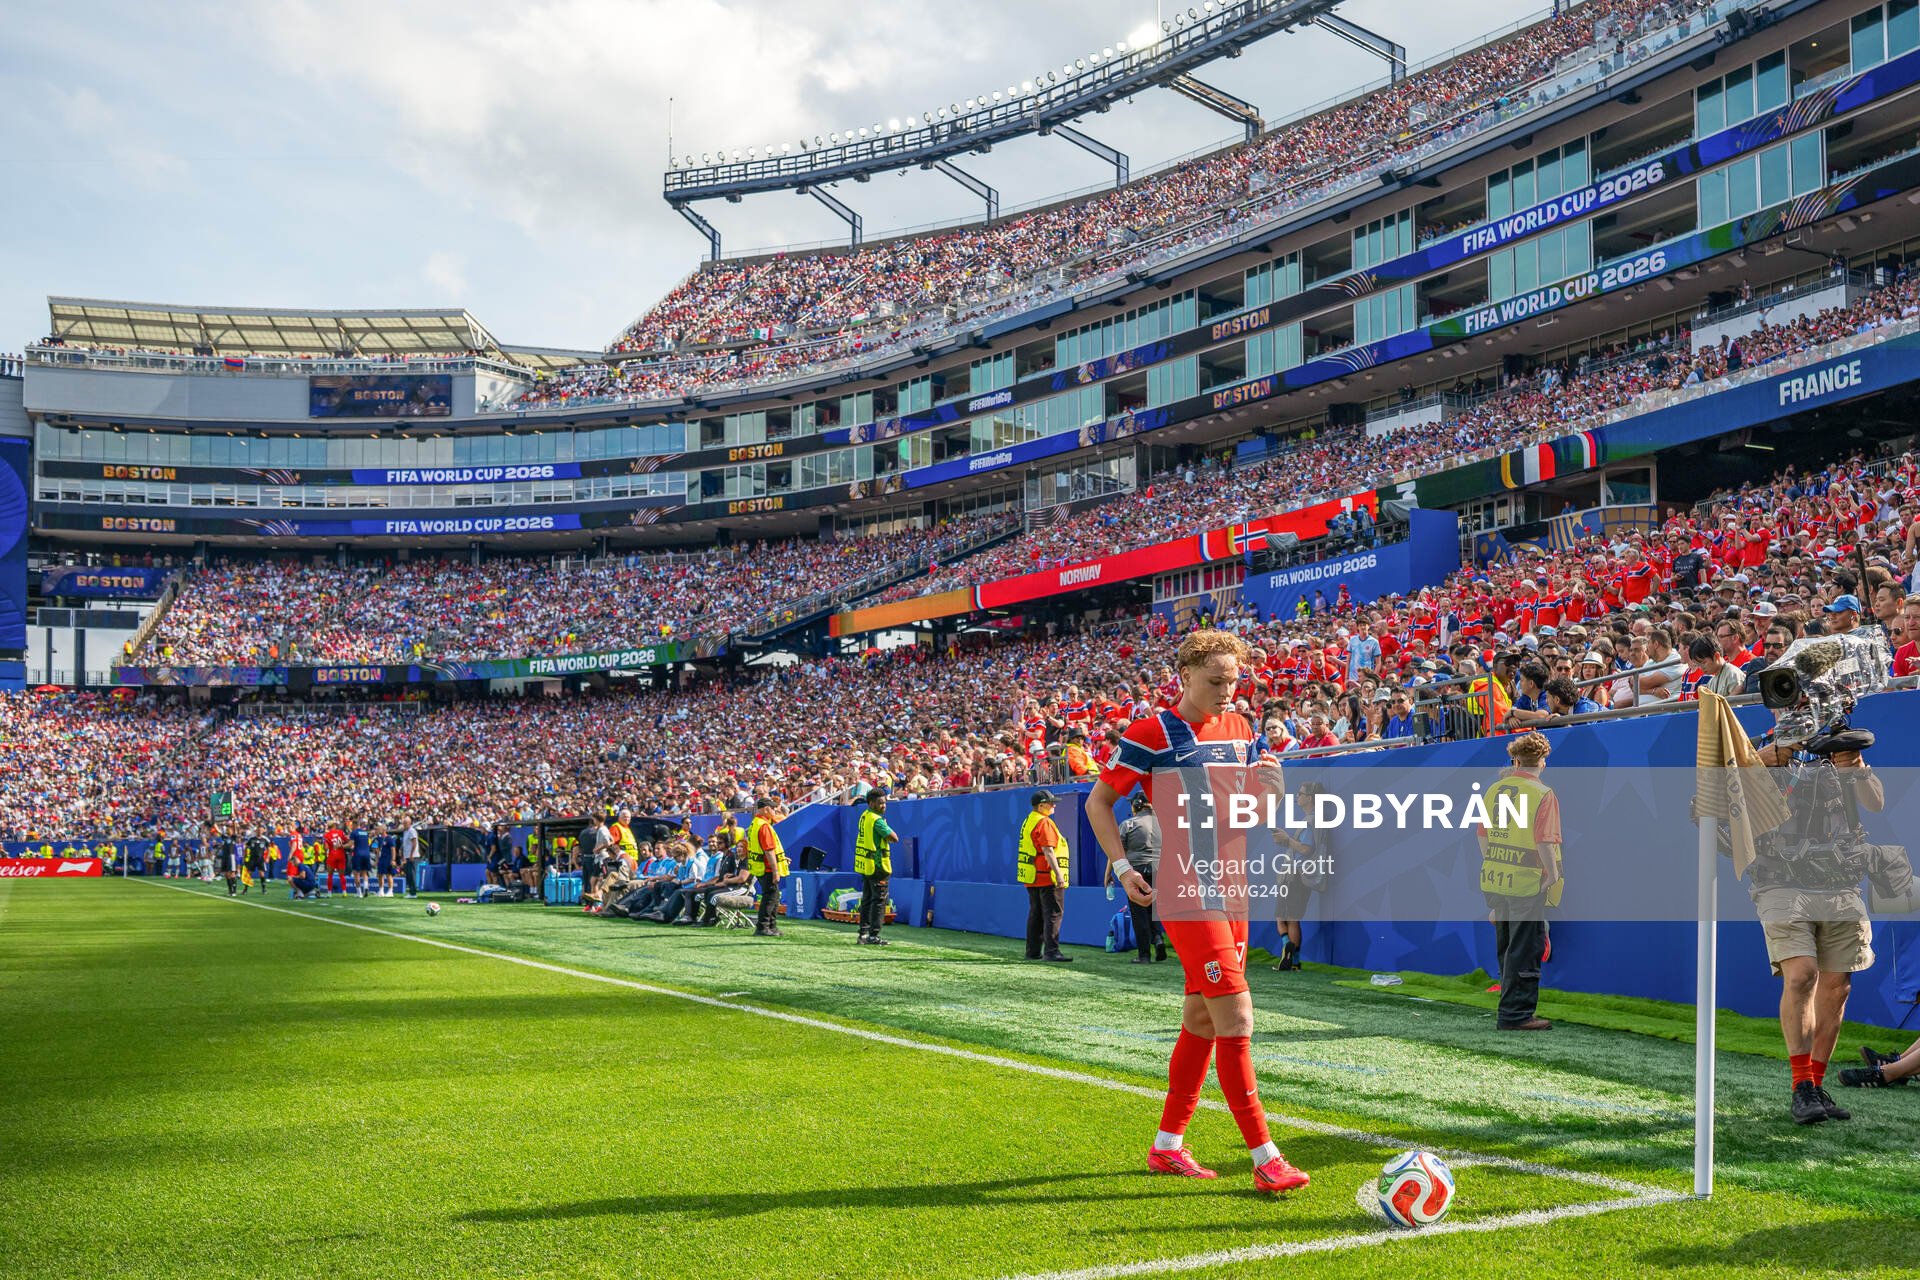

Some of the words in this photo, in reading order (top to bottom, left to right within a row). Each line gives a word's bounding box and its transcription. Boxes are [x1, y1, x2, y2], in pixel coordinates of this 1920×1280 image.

[1463, 228, 1497, 254] FIFA
[1499, 203, 1559, 241] WORLD
[1561, 188, 1597, 216] CUP
[1599, 161, 1664, 203] 2026
[1465, 307, 1499, 334] FIFA
[1501, 285, 1561, 322] WORLD
[1563, 274, 1599, 301] CUP
[1602, 251, 1666, 290] 2026
[1212, 307, 1270, 340] BOSTON
[1780, 360, 1862, 406] FRANCE
[354, 390, 405, 400] BOSTON
[969, 392, 1012, 412] #FIFAWorldCup
[1213, 378, 1271, 409] BOSTON
[728, 443, 783, 461] BOSTON
[969, 452, 1012, 471] #FIFAWorldCup
[103, 465, 176, 480] BOSTON
[386, 470, 418, 483] FIFA
[421, 469, 473, 482] WORLD
[475, 467, 503, 480] CUP
[505, 465, 554, 479] 2026
[728, 496, 783, 514] BOSTON
[102, 517, 176, 531] BOSTON
[386, 521, 418, 533] FIFA
[420, 520, 472, 532] WORLD
[474, 519, 502, 531] CUP
[504, 516, 554, 530] 2026
[1060, 564, 1101, 587] NORWAY
[1270, 574, 1289, 588] FIFA
[1289, 567, 1322, 584] WORLD
[1323, 562, 1342, 578] CUP
[1343, 554, 1377, 574] 2026
[76, 575, 144, 588] BOSTON
[529, 660, 555, 673] FIFA
[556, 656, 597, 671] WORLD
[599, 653, 619, 668] CUP
[620, 649, 655, 666] 2026
[317, 668, 381, 681] BOSTON
[1486, 845, 1526, 864] CURITY
[0, 861, 46, 876] eiser
